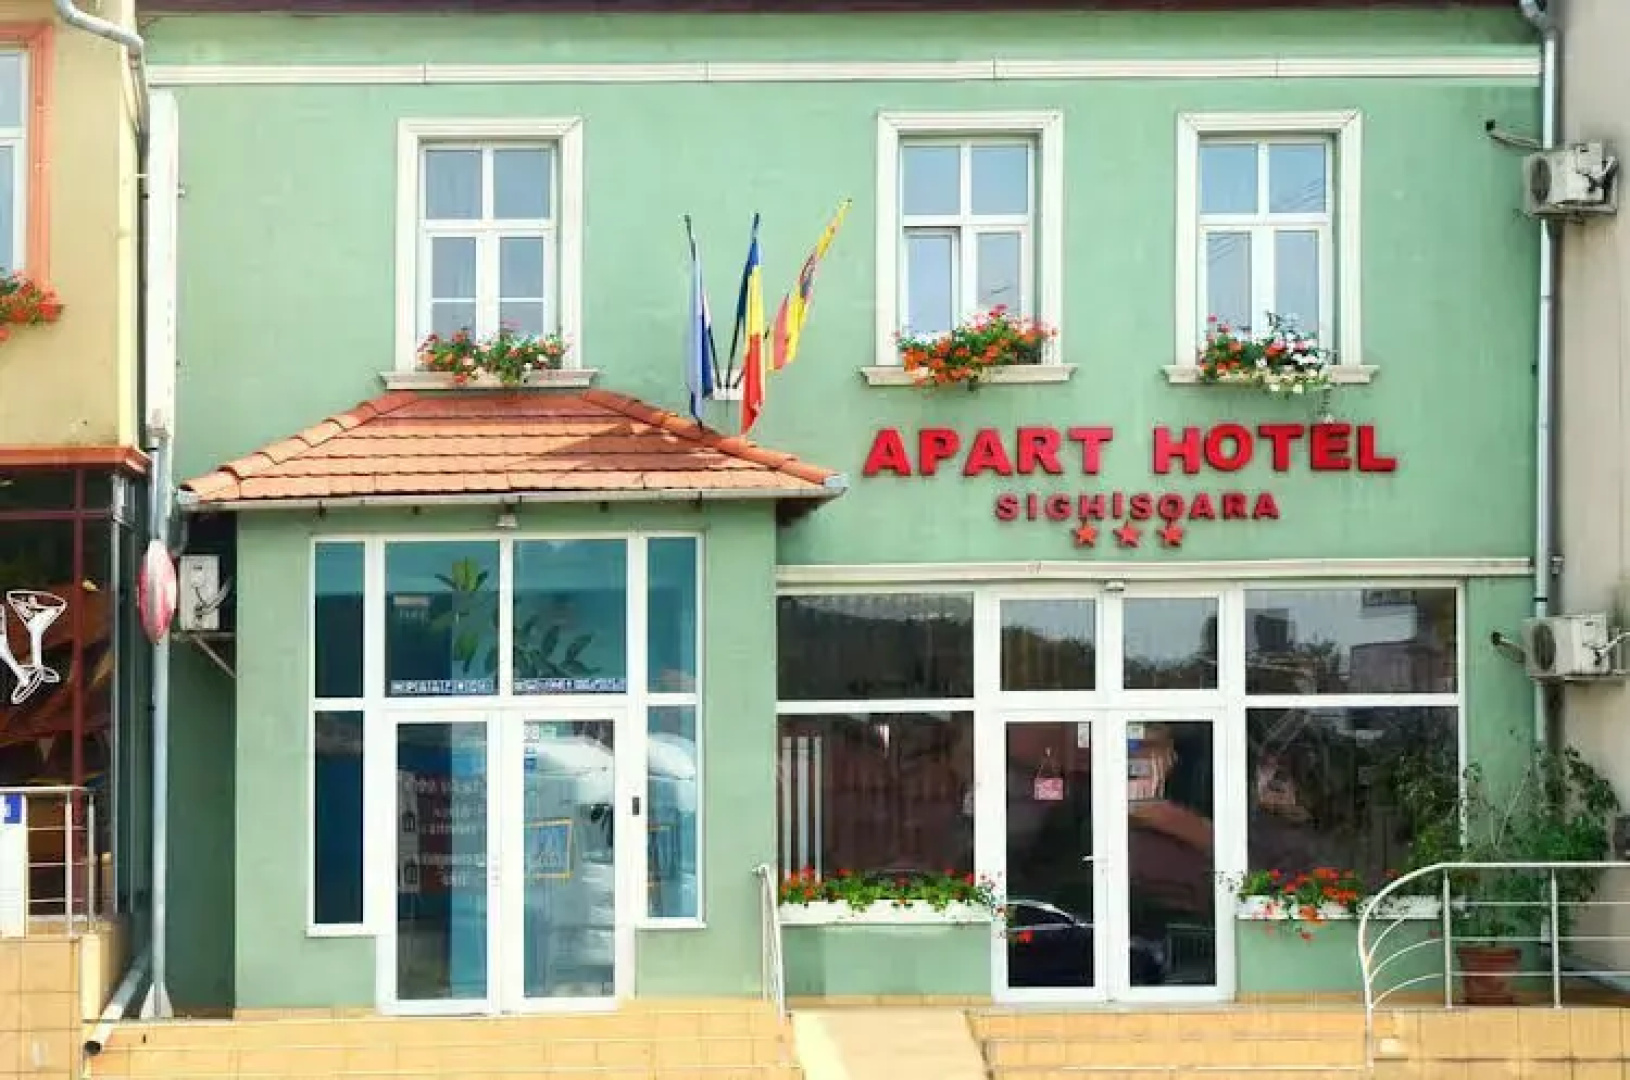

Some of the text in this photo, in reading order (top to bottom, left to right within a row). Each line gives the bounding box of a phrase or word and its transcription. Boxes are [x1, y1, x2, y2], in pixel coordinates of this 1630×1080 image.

[863, 422, 1398, 477] APART HOTEL
[995, 491, 1281, 520] SIGHISOARA
